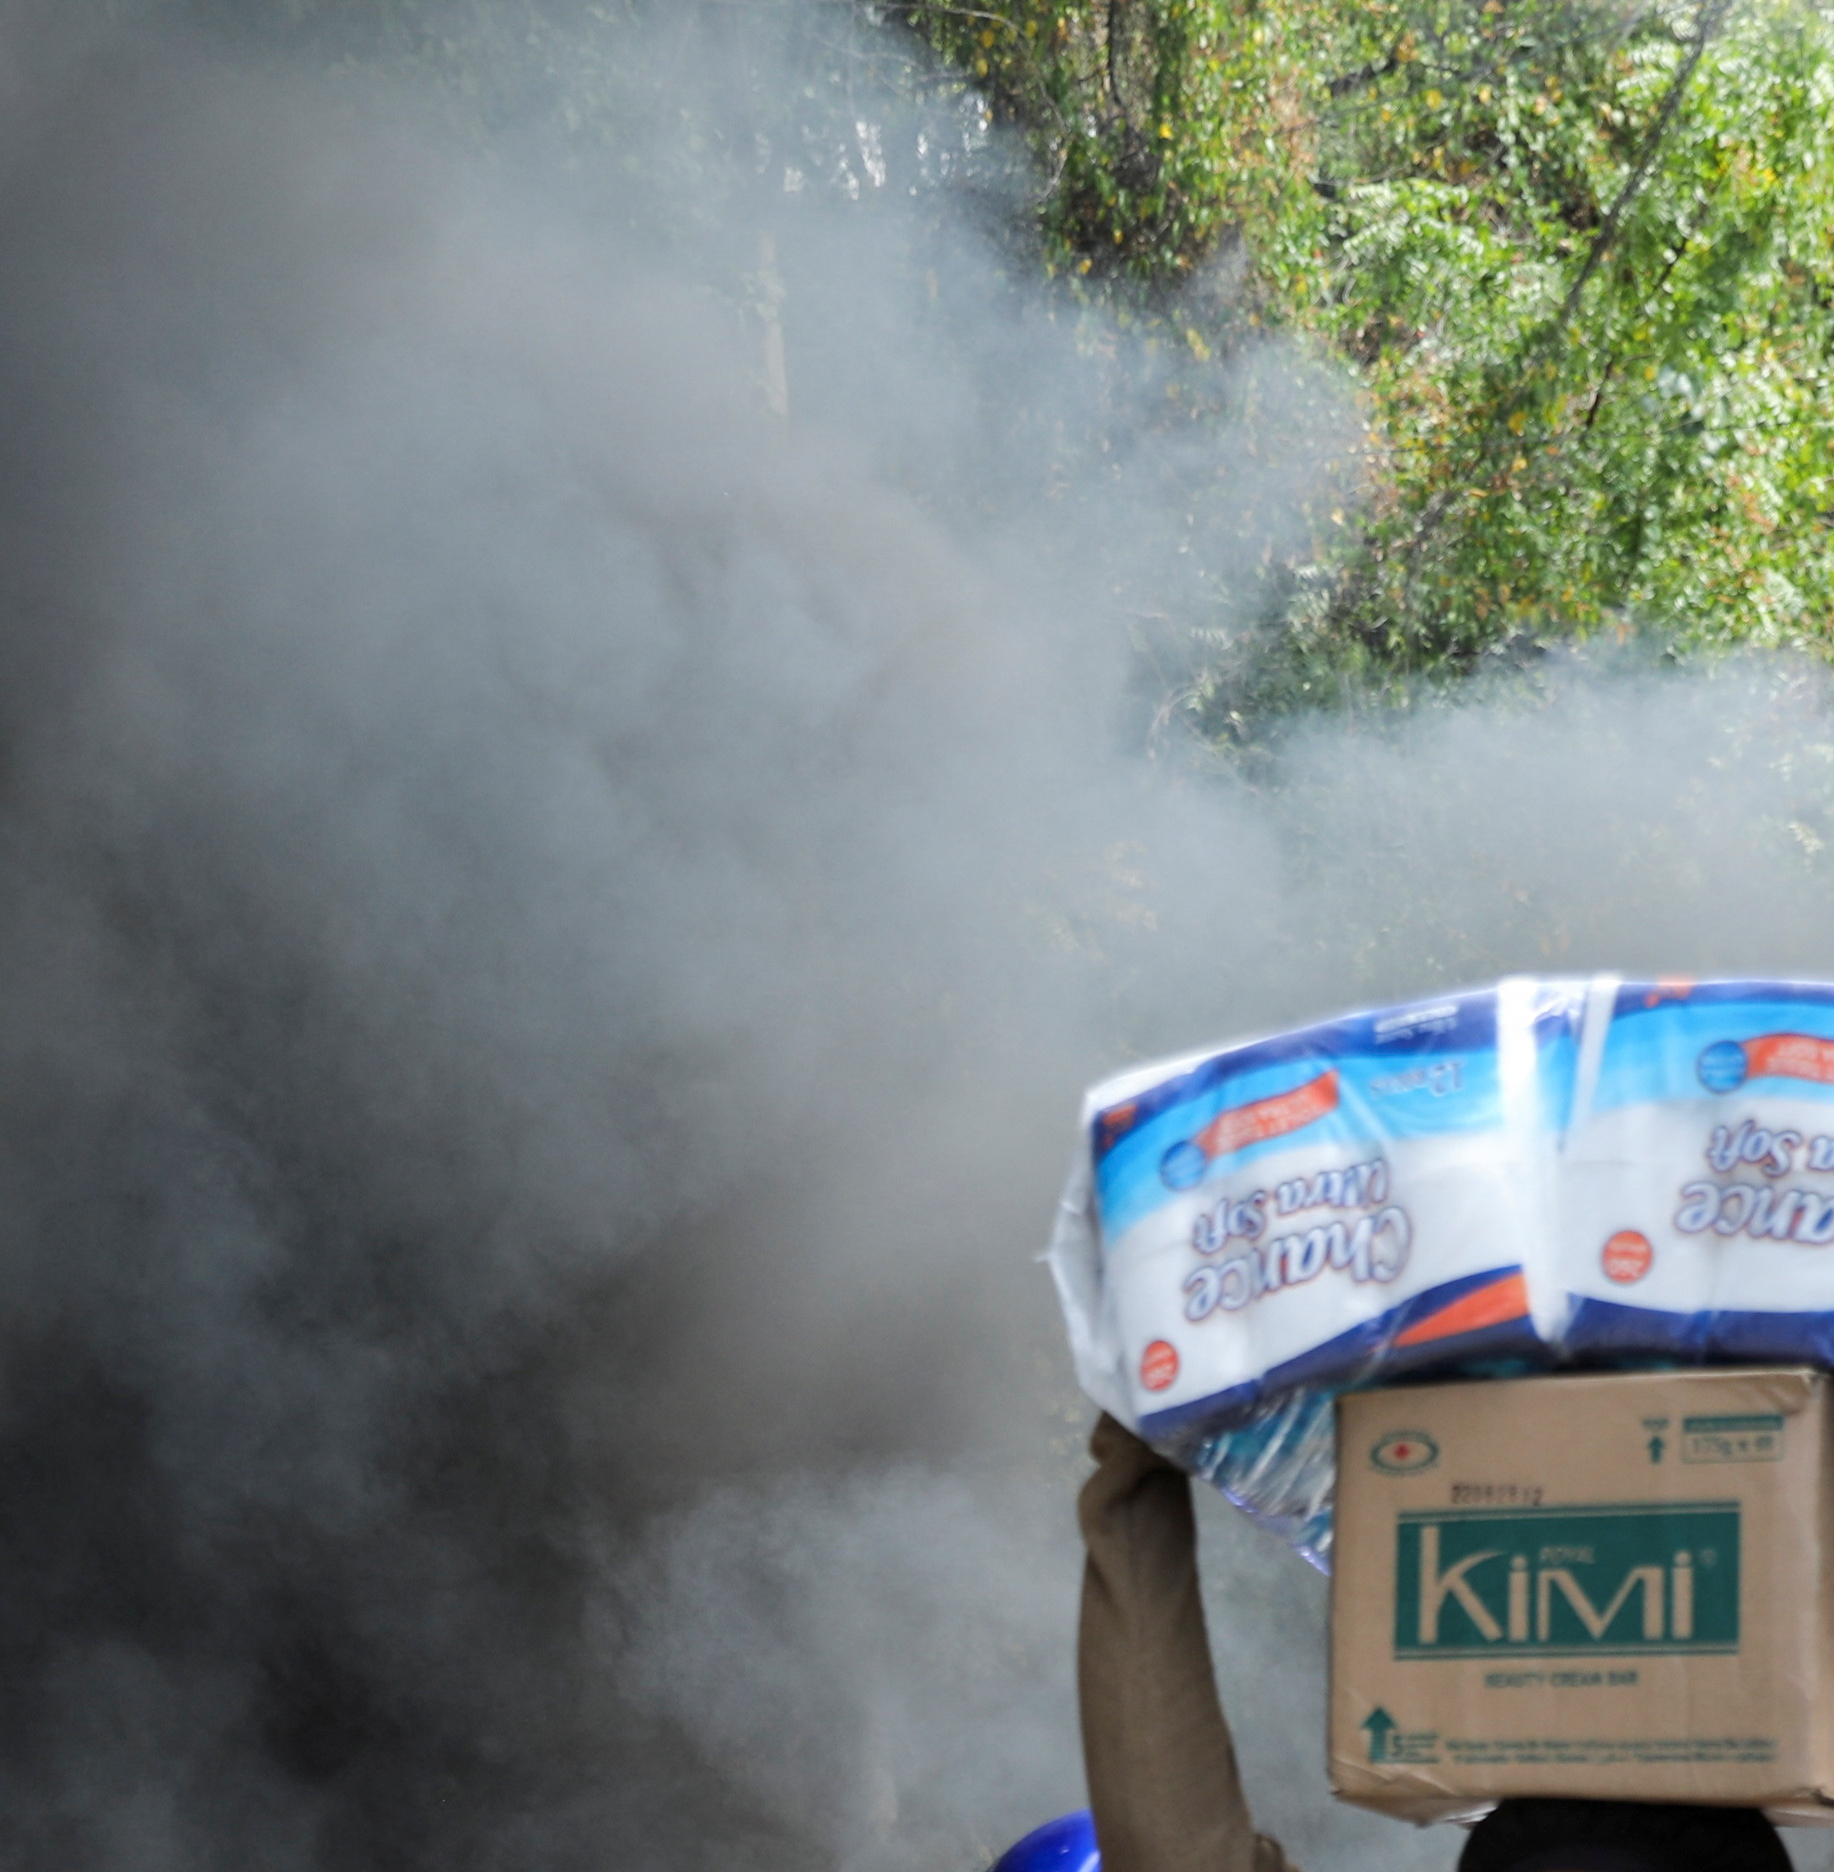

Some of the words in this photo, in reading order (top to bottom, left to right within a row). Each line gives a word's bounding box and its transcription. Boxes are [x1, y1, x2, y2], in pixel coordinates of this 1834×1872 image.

[1706, 1119, 1803, 1178] Soft
[1274, 1157, 1389, 1216] Ultra
[1192, 1189, 1268, 1256] Soft
[1181, 1206, 1413, 1323] Chance
